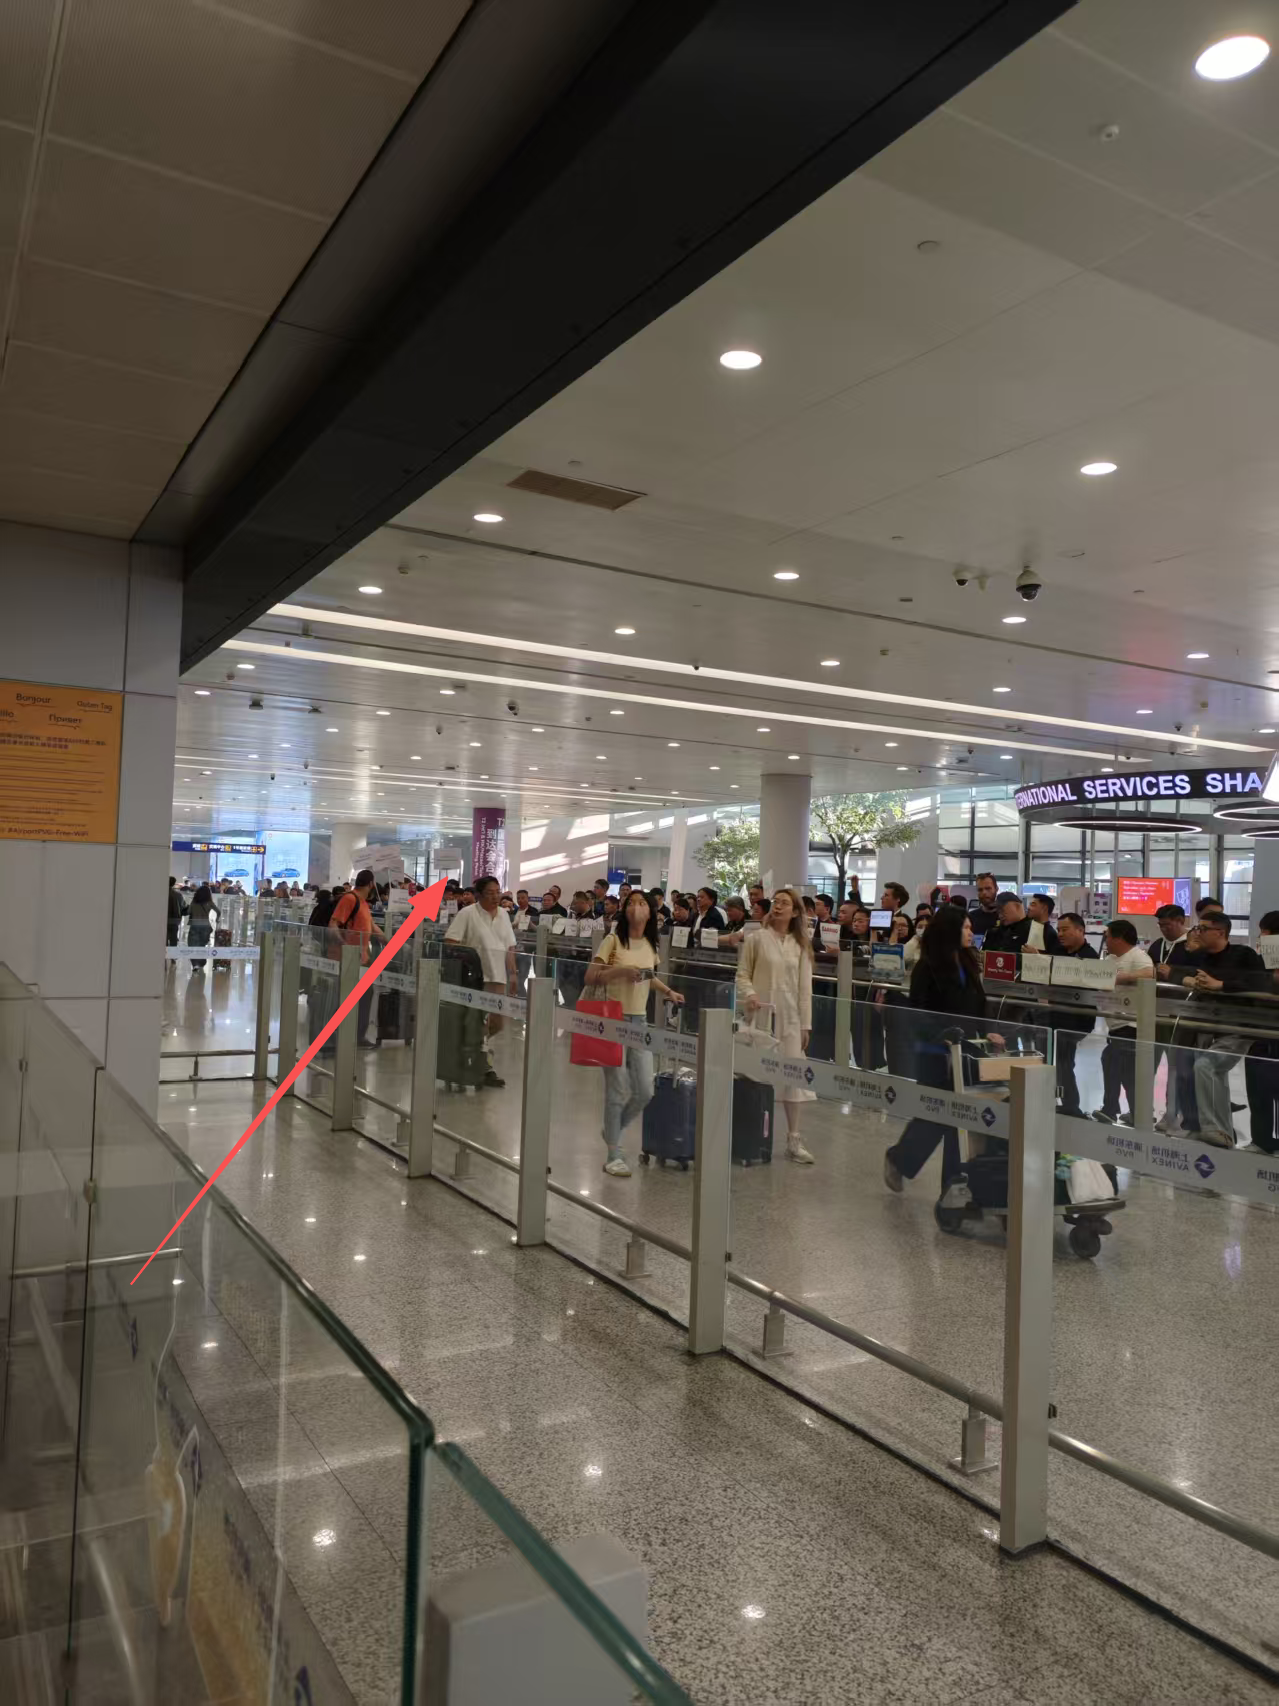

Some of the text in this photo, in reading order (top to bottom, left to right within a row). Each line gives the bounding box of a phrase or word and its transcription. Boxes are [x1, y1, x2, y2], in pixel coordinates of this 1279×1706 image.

[16, 692, 52, 704] Bonjour
[1015, 772, 1265, 809] ERNATIONAL SERVICES SHA
[485, 828, 497, 877] 到达会合
